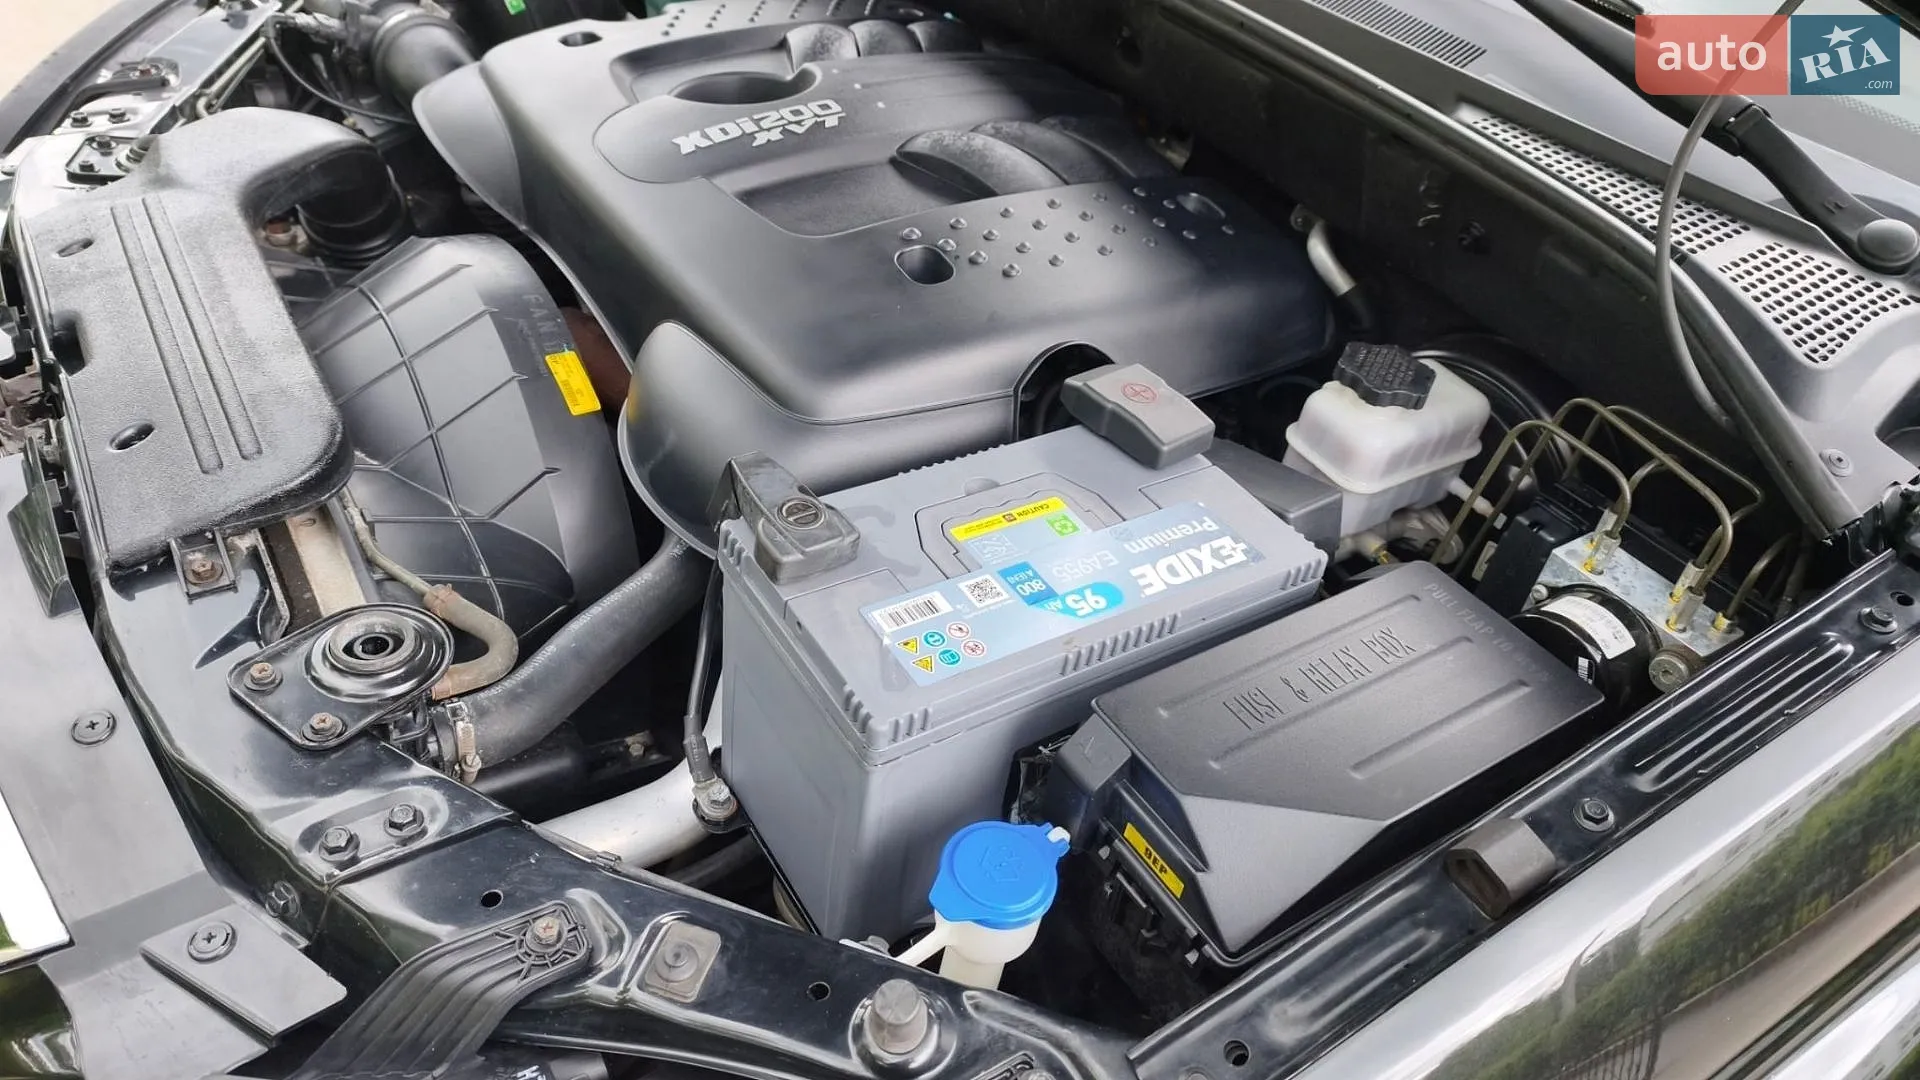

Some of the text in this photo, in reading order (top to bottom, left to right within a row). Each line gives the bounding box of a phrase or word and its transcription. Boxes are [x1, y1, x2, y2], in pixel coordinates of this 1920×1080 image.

[1016, 503, 1050, 517] CAUTION
[1123, 516, 1219, 554] Premium
[1052, 550, 1119, 583] EA955
[1129, 536, 1248, 596] EXIDE
[1016, 579, 1046, 596] 800
[1064, 587, 1108, 617] 95
[1423, 582, 1459, 608] PULL
[1455, 607, 1495, 635] FLAP
[1280, 674, 1312, 704] &
[1298, 645, 1373, 695] RELAY
[1359, 626, 1417, 665] BOX
